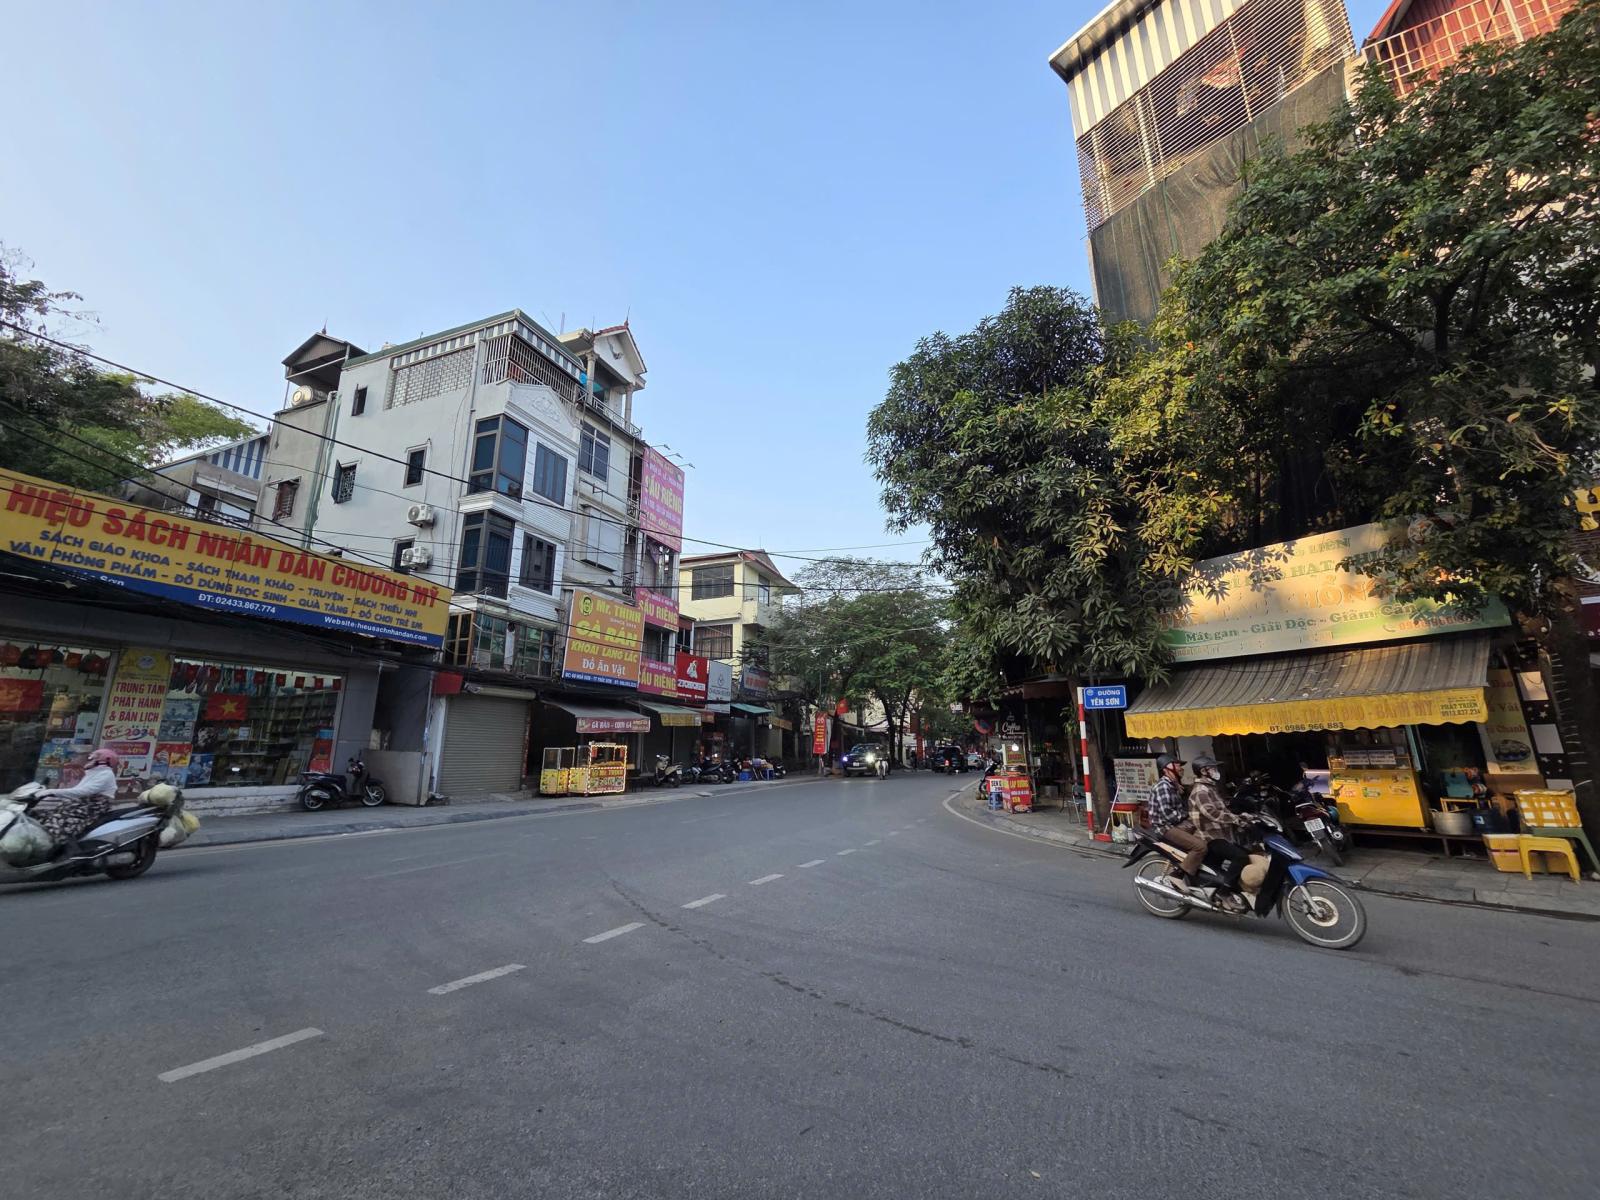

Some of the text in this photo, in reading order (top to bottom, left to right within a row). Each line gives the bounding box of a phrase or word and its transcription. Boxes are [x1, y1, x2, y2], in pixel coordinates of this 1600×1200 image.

[5, 483, 440, 608] HIỆU SÁCH NHÂN DÂN CHƯƠNG MỸ
[40, 530, 84, 548] SÁCH
[89, 541, 126, 556] GIÁO
[131, 550, 170, 566] KHOA
[186, 559, 220, 576] SÁCH
[225, 569, 260, 584] THAM
[265, 576, 295, 591] KHẢO
[9, 540, 46, 558] VĂN
[51, 550, 105, 568] PHÒNG
[110, 561, 157, 579] PHẨM
[174, 573, 194, 585] ĐỒ
[198, 578, 233, 593] DÙNG
[235, 585, 259, 598] HỌC
[262, 591, 288, 603] SINH
[575, 619, 638, 648] GÀ RÁN
[570, 640, 599, 654] KHOAI
[602, 647, 623, 660] LANG
[115, 681, 166, 695] TRUNG TÂM
[112, 696, 162, 709] PHÁT HÀNH
[1090, 696, 1120, 706] YÊN SƠN
[1327, 721, 1344, 729] 883
